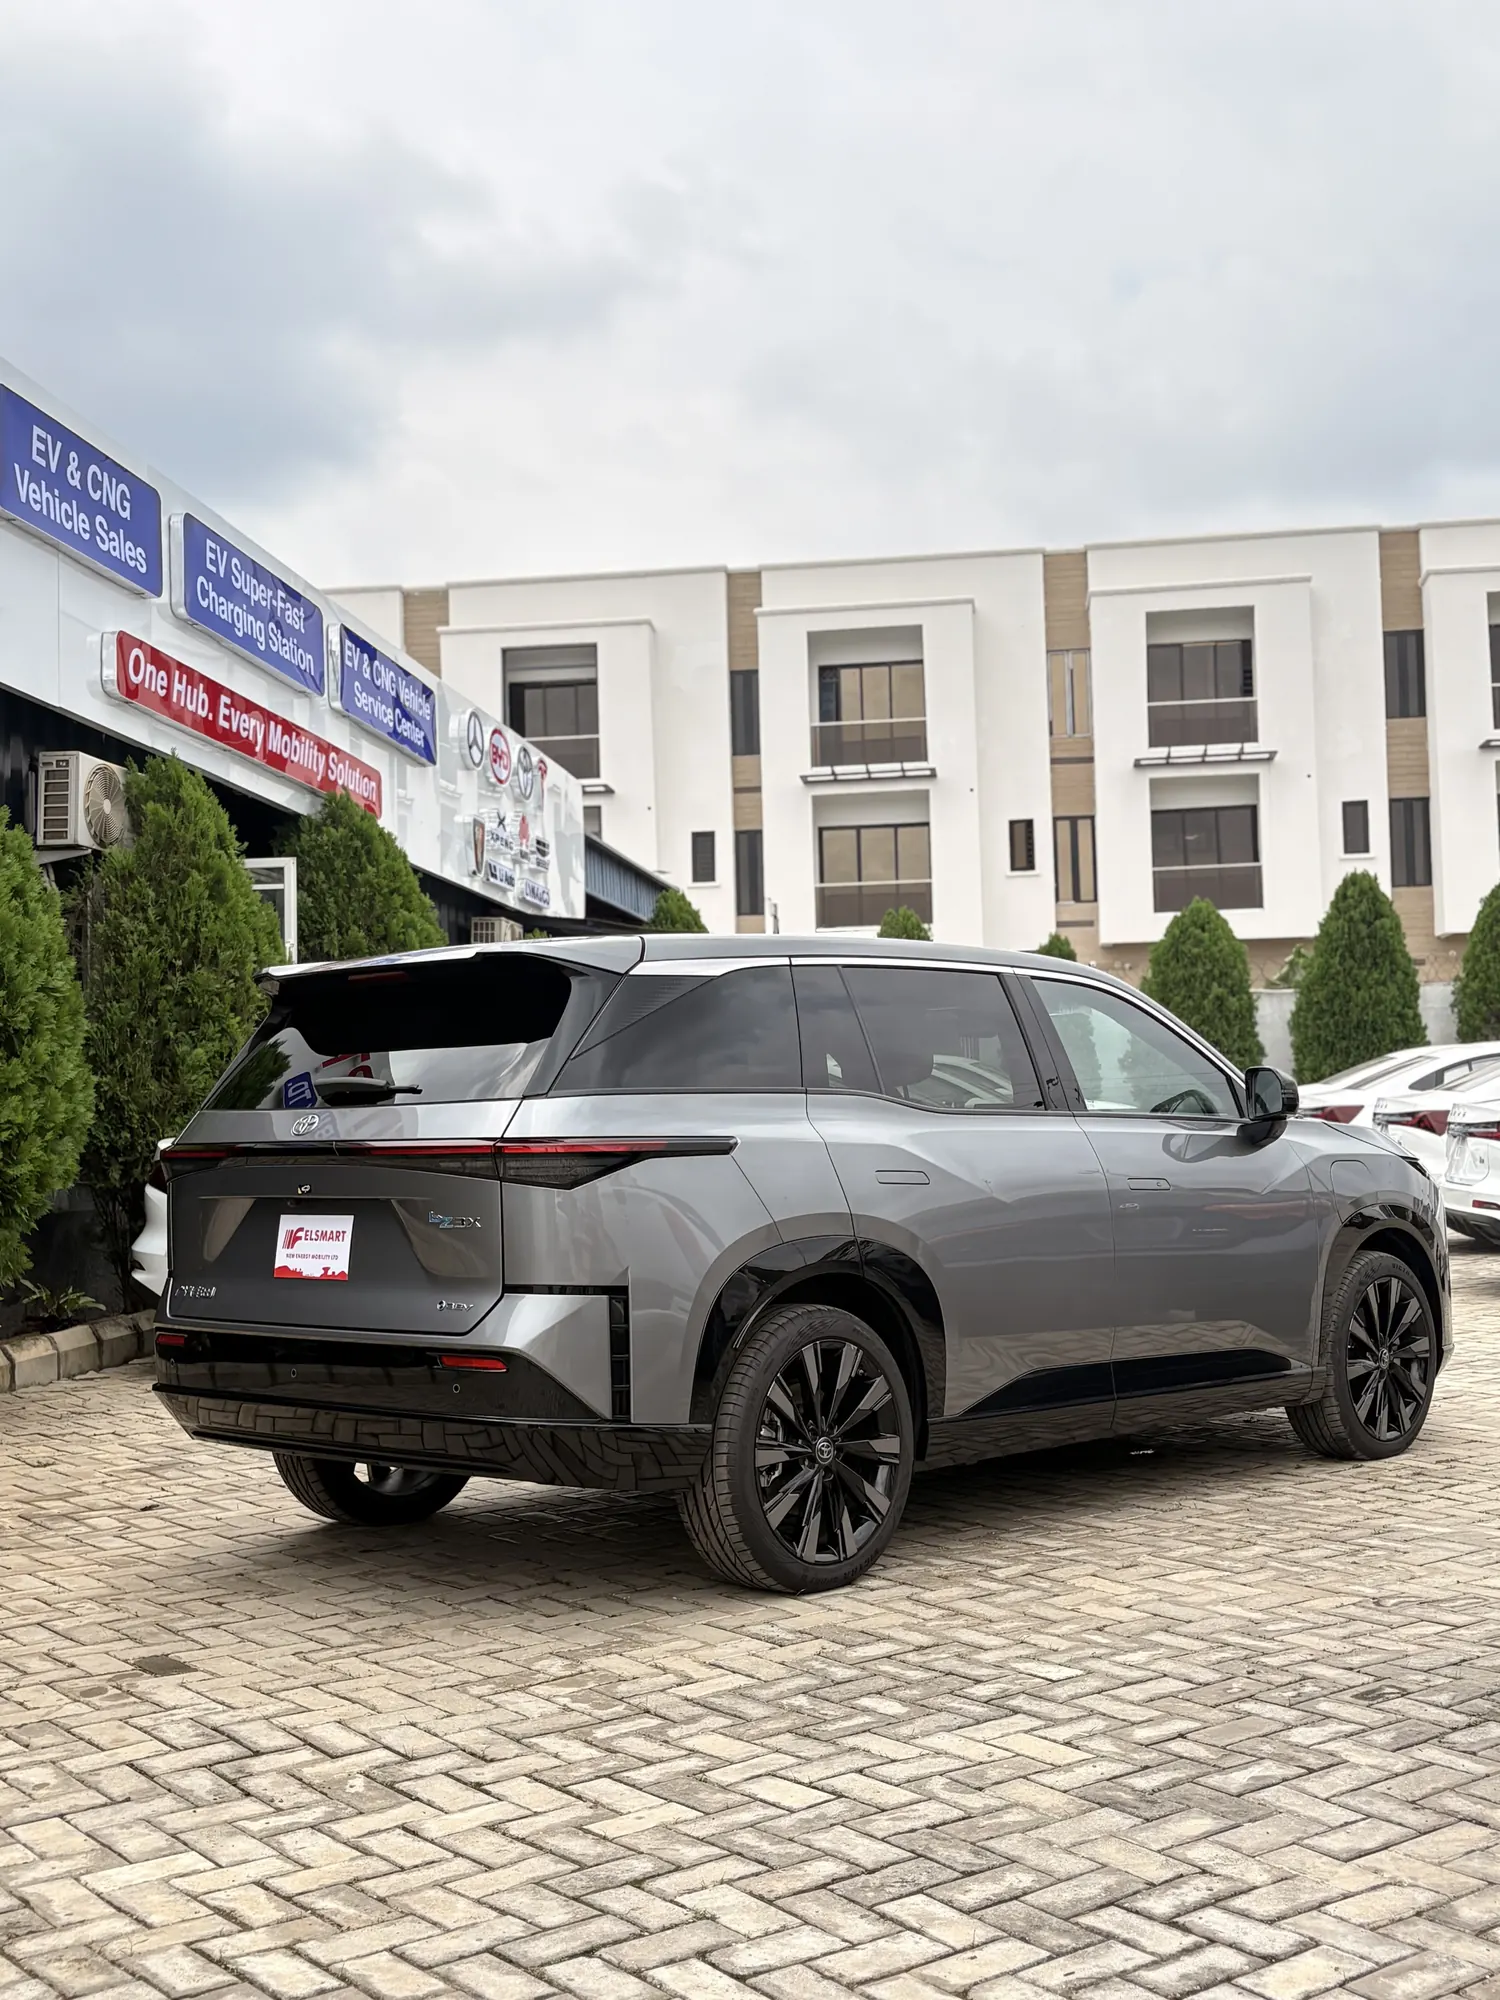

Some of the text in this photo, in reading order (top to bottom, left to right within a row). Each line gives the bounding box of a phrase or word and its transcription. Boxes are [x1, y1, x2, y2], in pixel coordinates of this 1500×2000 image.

[13, 462, 147, 574] Vehicle Sales
[31, 424, 131, 521] EV & CNG
[196, 575, 315, 676] Charging Station
[206, 538, 305, 634] EV Super-Fast
[128, 647, 377, 801] One Hub. Every Mobility Solution
[344, 638, 431, 721] EV & CNG Vehicle
[354, 680, 425, 748] Service Center
[491, 743, 509, 770] BYD
